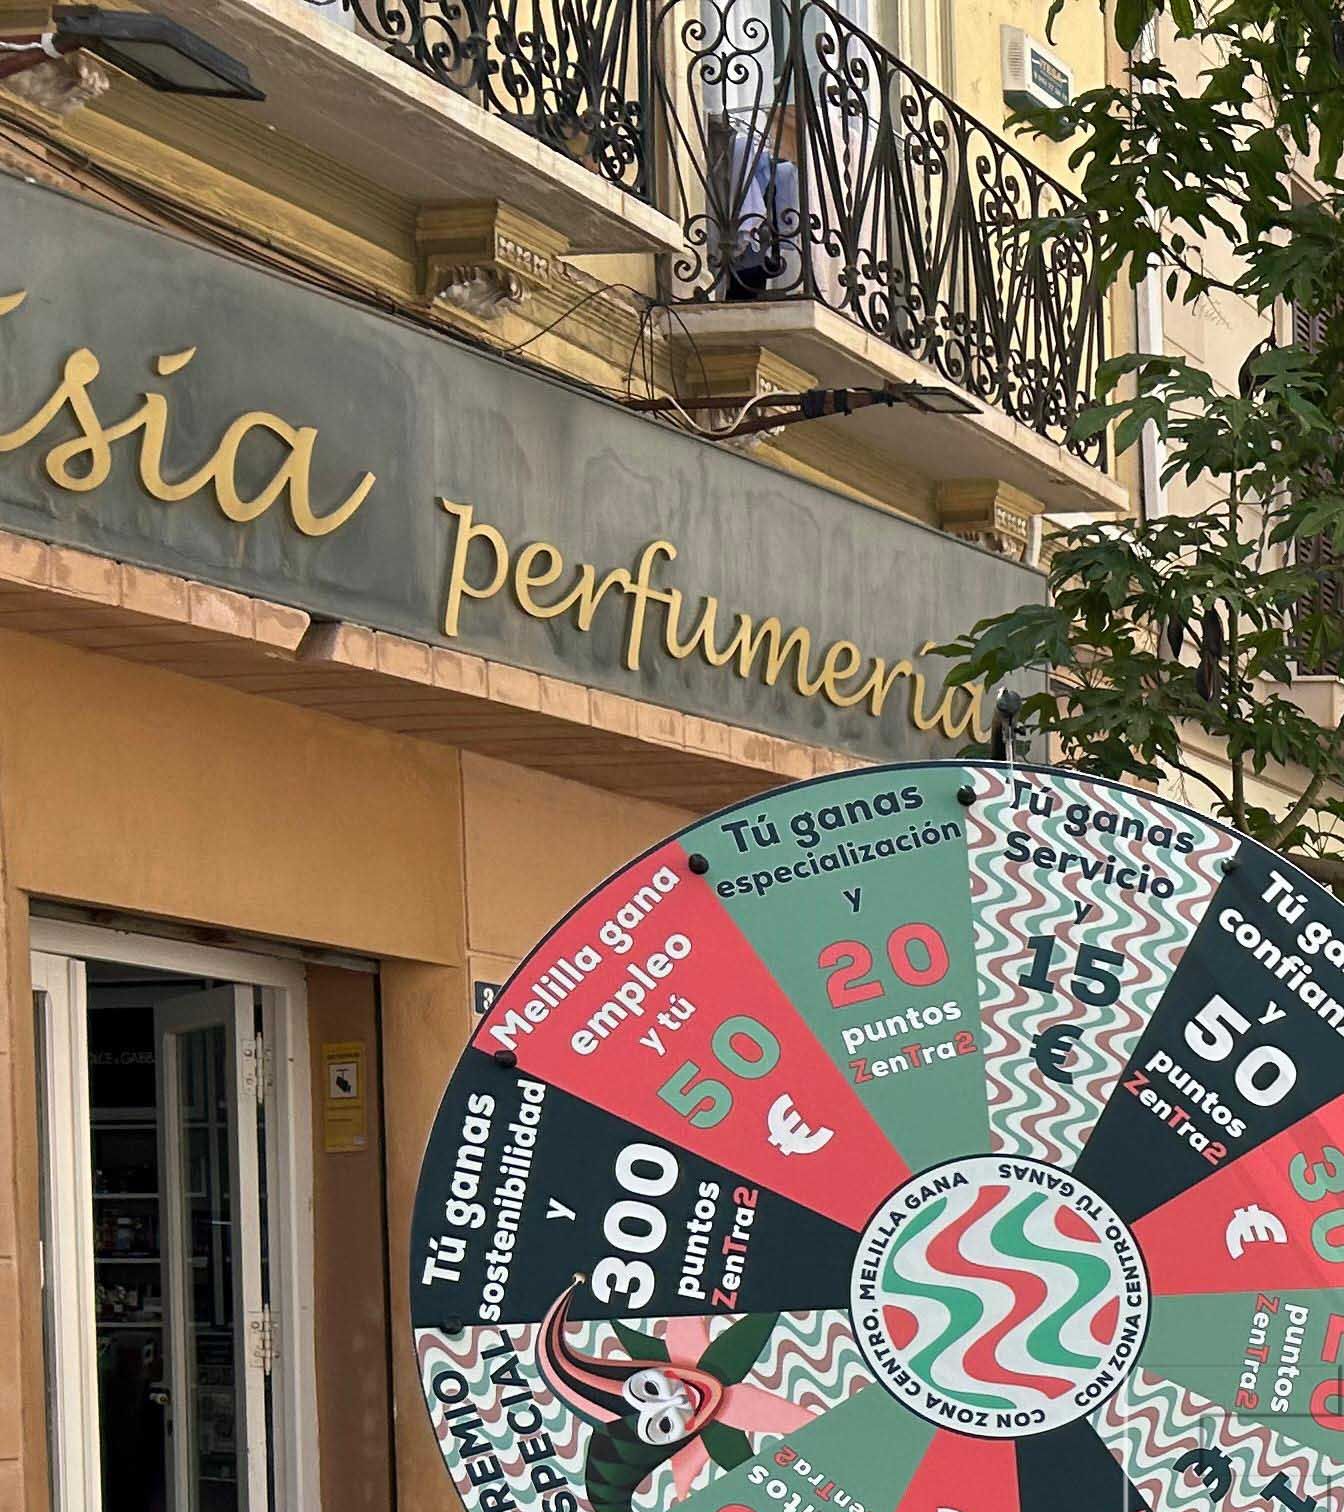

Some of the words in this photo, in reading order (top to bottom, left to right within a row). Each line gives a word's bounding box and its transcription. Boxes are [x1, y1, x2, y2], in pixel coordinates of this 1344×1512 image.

[440, 497, 992, 743] perfumería
[722, 814, 781, 855] Tú
[790, 785, 924, 849] ganas
[1005, 778, 1054, 819] Tú
[1063, 802, 1196, 855] ganas
[716, 819, 963, 899] especialización
[1003, 830, 1175, 899] Servicio
[843, 887, 863, 913] y
[1073, 898, 1093, 925] y
[1260, 870, 1307, 924] Tú
[488, 944, 603, 1052] Melilla
[599, 864, 680, 953] gana
[816, 923, 951, 1010] 20
[1018, 935, 1126, 1007] 15
[569, 933, 693, 1056] empleo
[639, 1027, 666, 1055] y
[657, 995, 696, 1028] tú
[841, 1000, 962, 1054] puntos
[1258, 1001, 1288, 1026] y
[657, 1016, 782, 1129] 50
[848, 1031, 977, 1086] ZenTra2
[1029, 1023, 1084, 1086] €
[1183, 993, 1297, 1108] 50
[767, 1093, 835, 1157] €
[1123, 1070, 1229, 1167] ZenTra2
[1143, 1049, 1248, 1138] puntos
[423, 1238, 466, 1288] Tú
[446, 1093, 496, 1230] ganas
[479, 1078, 546, 1322] sostenibilidad
[546, 1197, 577, 1222] y
[904, 1171, 969, 1209] GANA
[998, 1164, 1075, 1197] GANAS
[1075, 1195, 1103, 1220] TÚ
[591, 1143, 679, 1309] 300
[678, 1180, 720, 1301] puntos
[712, 1186, 760, 1310] ZenTra2
[859, 1211, 907, 1300] MELILLA
[1224, 1204, 1288, 1260] €
[1105, 1217, 1142, 1308] CENTRO,
[863, 1308, 922, 1396] CENTRO,
[1108, 1313, 1141, 1372] ZONA
[1235, 1293, 1280, 1411] ZenTra2
[1270, 1303, 1309, 1415] puntos
[925, 1392, 988, 1427] ZONA
[996, 1409, 1046, 1428] CON
[1074, 1371, 1116, 1407] CON
[1172, 1446, 1234, 1504] €
